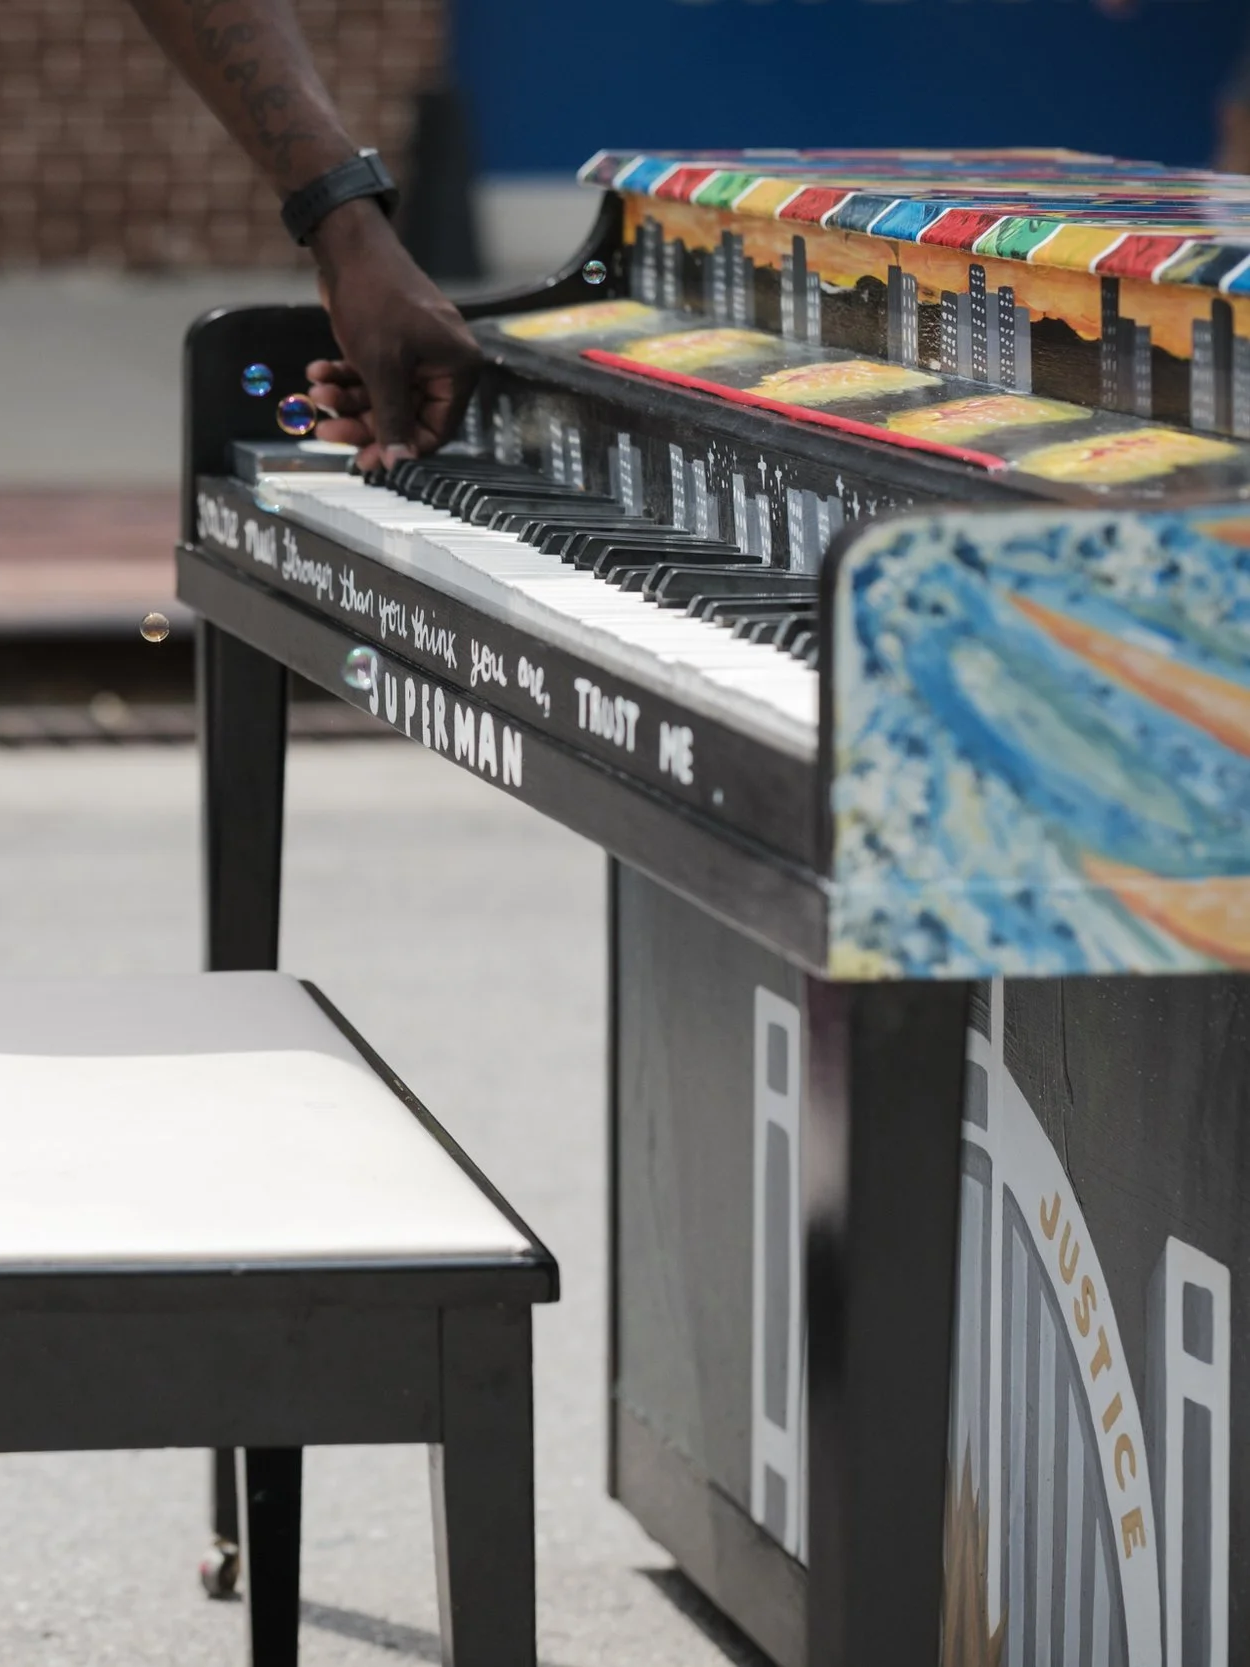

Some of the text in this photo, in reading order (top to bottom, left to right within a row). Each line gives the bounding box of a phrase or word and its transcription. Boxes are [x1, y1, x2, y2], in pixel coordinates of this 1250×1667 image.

[339, 565, 374, 617] than
[379, 595, 408, 639] you
[470, 638, 507, 687] you
[574, 677, 641, 753] TRUST
[1040, 1192, 1146, 1559] JUSTICE
